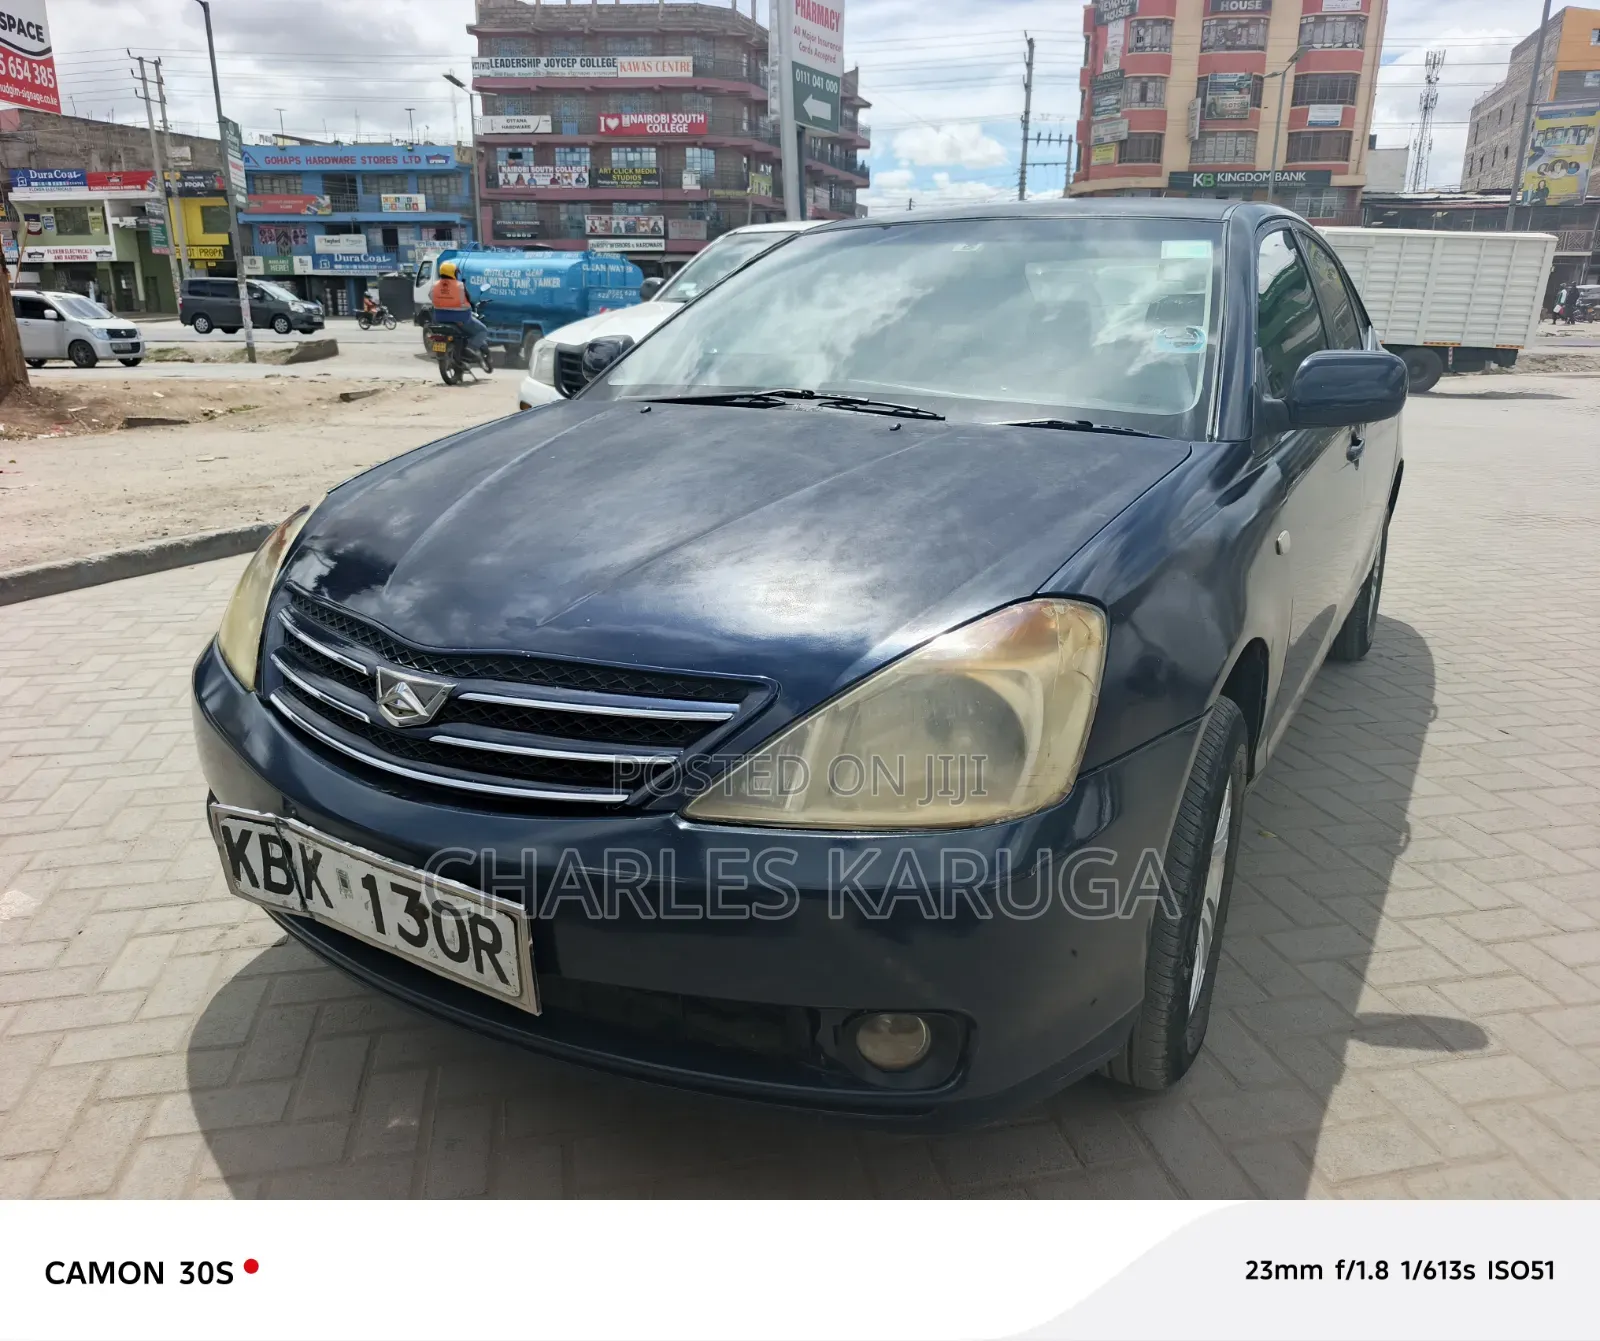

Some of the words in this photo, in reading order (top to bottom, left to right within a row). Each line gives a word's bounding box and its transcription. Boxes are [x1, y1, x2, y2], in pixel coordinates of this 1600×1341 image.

[1221, 0, 1263, 10] HOUSE
[795, 0, 841, 32] PHARMACY
[0, 11, 45, 43] SPACE
[802, 29, 816, 44] Major
[817, 35, 842, 52] Insurance
[799, 42, 813, 56] Cards
[490, 58, 541, 68] LEADERSHIP
[544, 57, 577, 68] JOYCEP
[580, 57, 617, 68] COLLEGE
[620, 60, 653, 73] KAWAS
[656, 60, 692, 73] CENTRE
[8, 56, 31, 82] 654
[32, 63, 55, 88] 385
[795, 68, 810, 85] 0111
[812, 75, 824, 91] 041
[825, 80, 838, 94] 000
[630, 113, 670, 123] NAIROBI
[671, 113, 705, 123] SOUTH
[646, 123, 688, 133] COLLEGE
[264, 156, 301, 165] GOHAPS
[305, 156, 356, 165] HARDWARE
[360, 155, 398, 165] STORES
[402, 155, 422, 164] LTD
[29, 169, 81, 179] DuraCoat
[1217, 172, 1272, 182] KINGDOM
[1274, 172, 1307, 182] BANK
[489, 276, 510, 287] WATER
[221, 825, 334, 909] KBK
[361, 873, 511, 985] 130R
